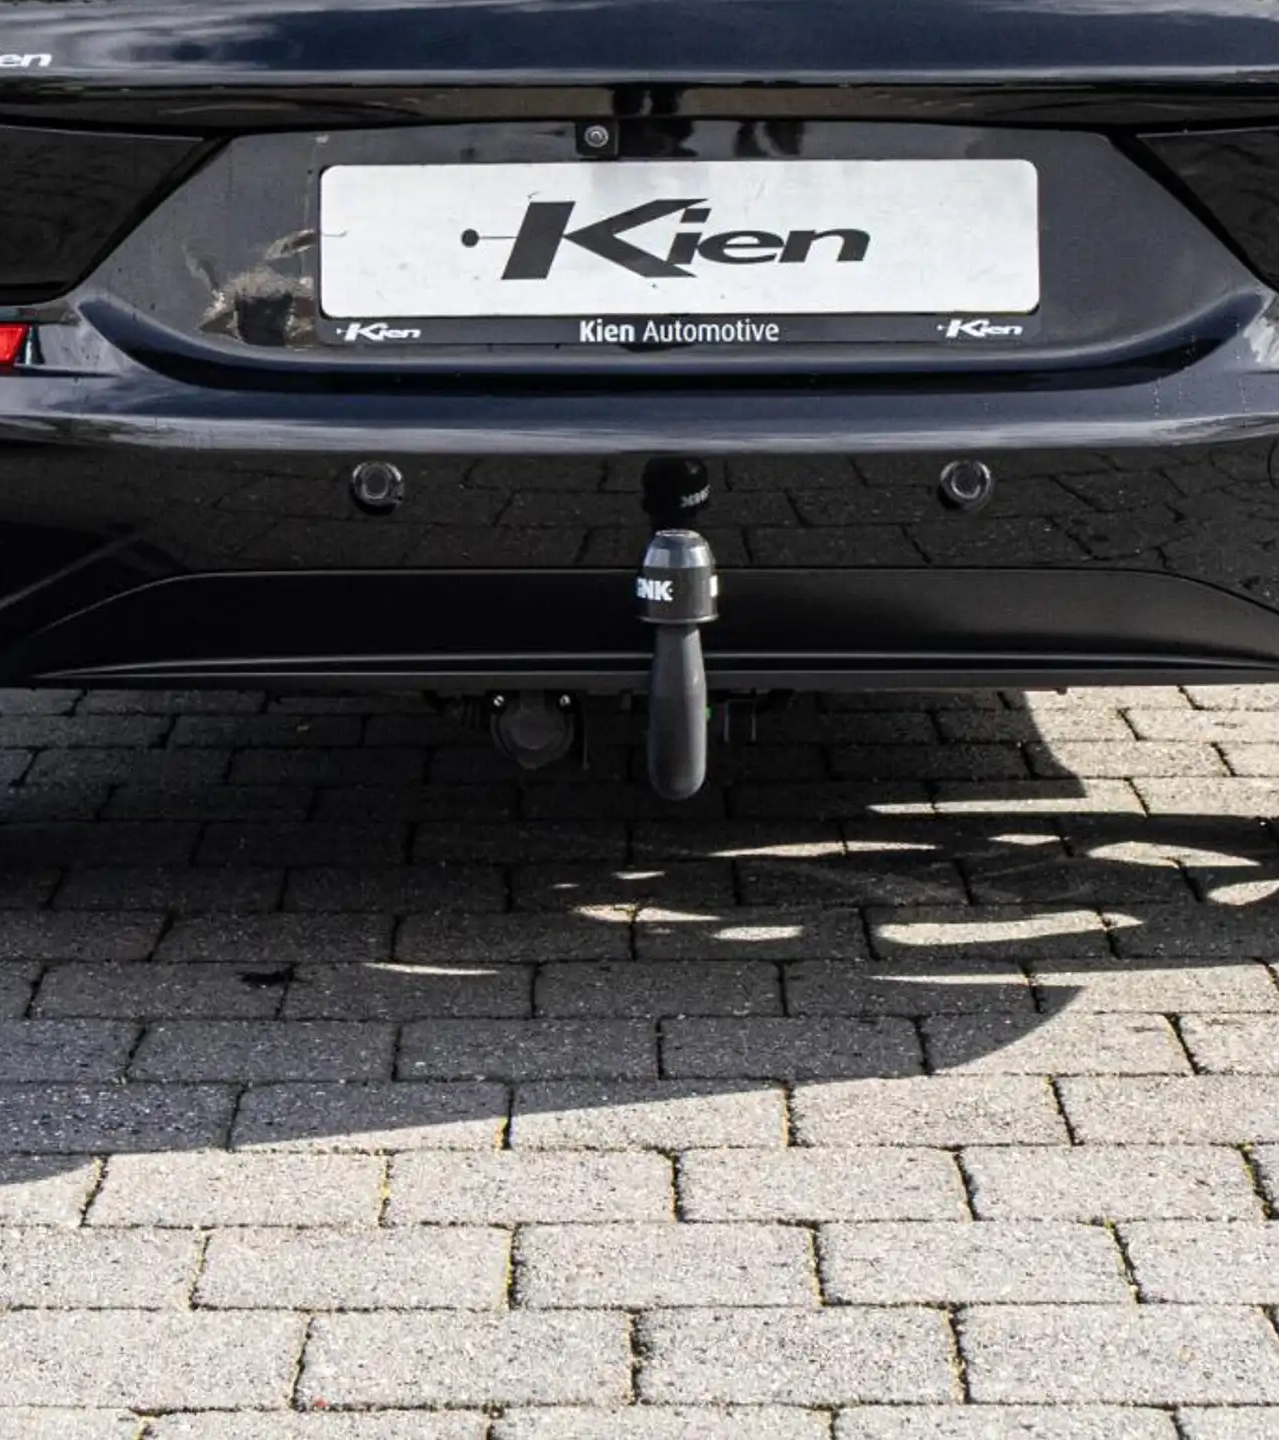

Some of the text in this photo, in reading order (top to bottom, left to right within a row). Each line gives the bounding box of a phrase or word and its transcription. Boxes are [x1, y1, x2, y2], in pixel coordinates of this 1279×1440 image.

[501, 198, 870, 280] Kien
[344, 322, 421, 342] Kien
[579, 318, 780, 343] Kien Automotive
[945, 318, 1023, 338] Kien
